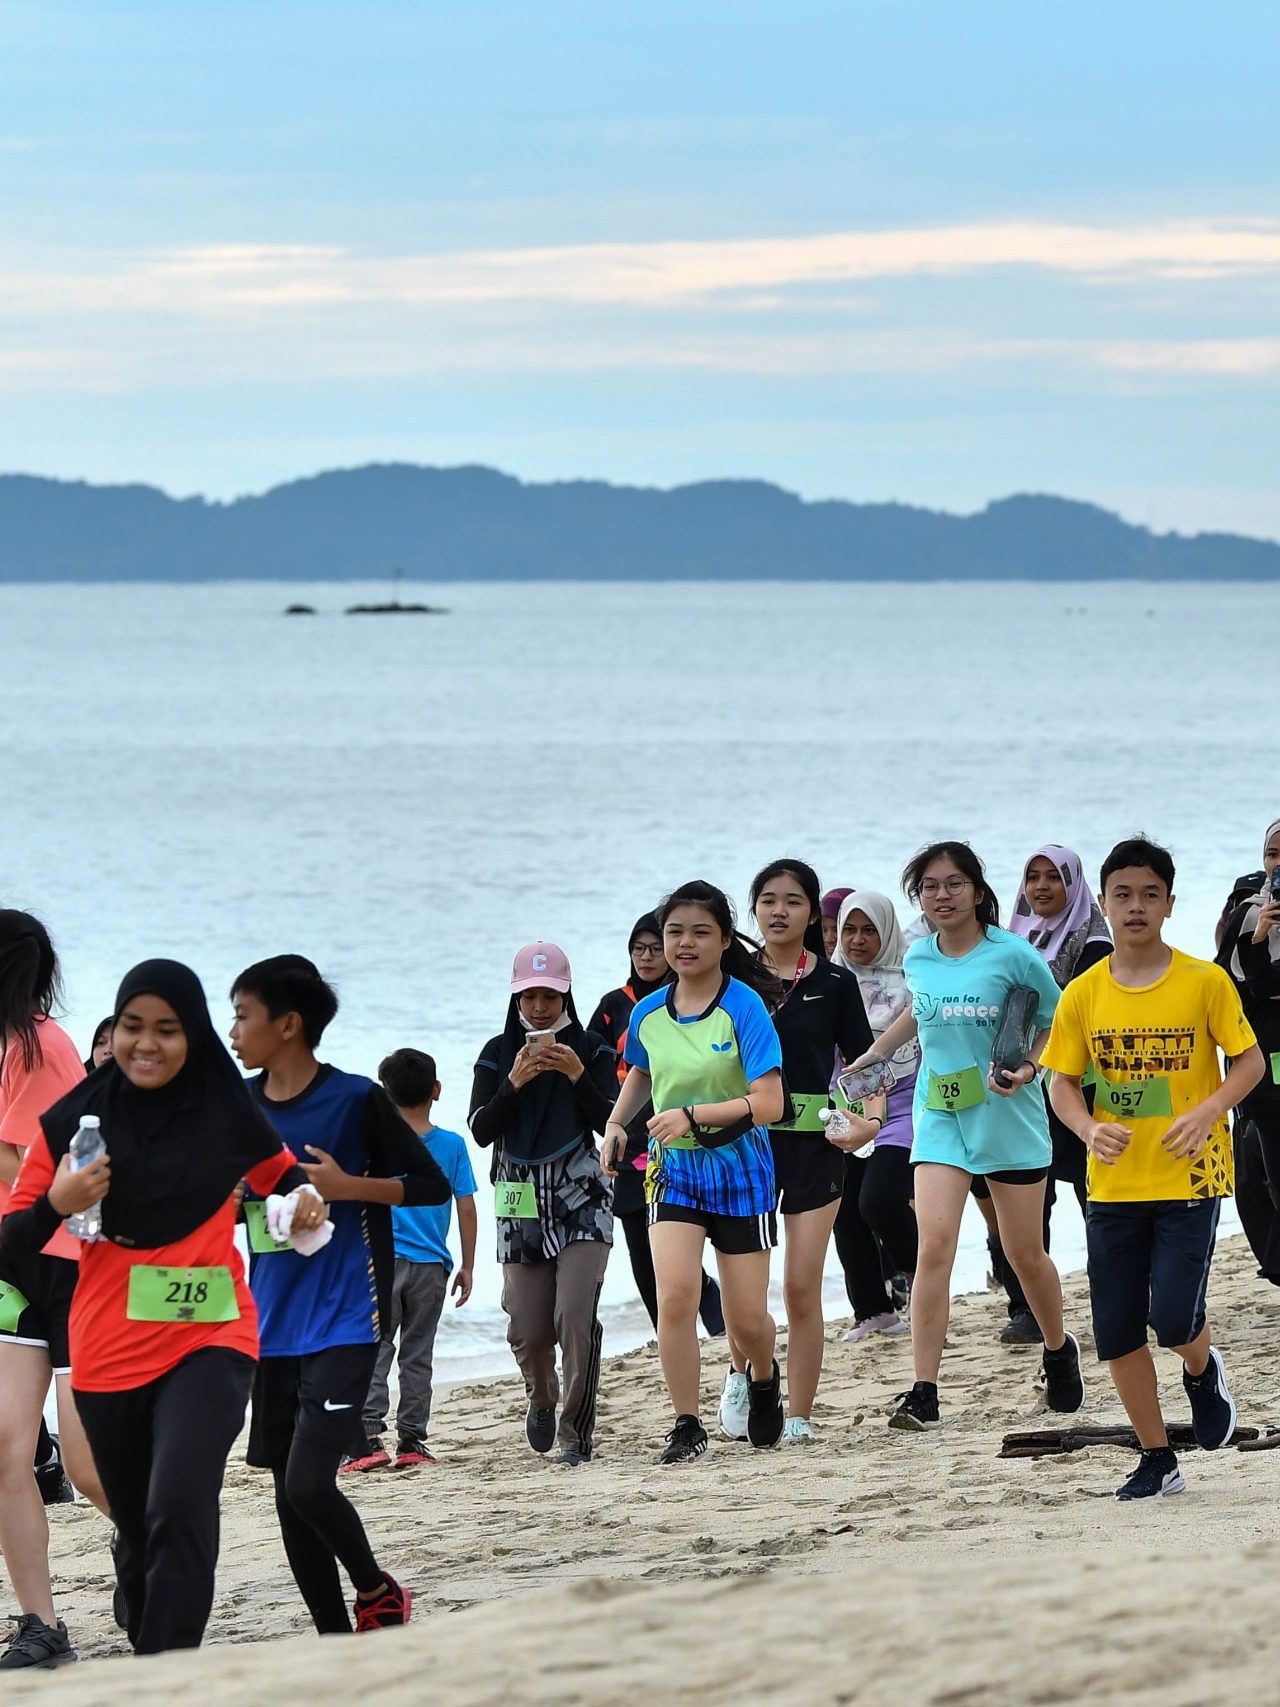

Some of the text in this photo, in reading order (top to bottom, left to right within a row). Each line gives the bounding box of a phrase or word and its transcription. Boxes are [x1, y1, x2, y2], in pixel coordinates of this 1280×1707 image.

[532, 954, 547, 972] C
[942, 994, 981, 1004] run for
[942, 1005, 1000, 1020] peace
[975, 1019, 997, 1028] 2017
[1110, 1091, 1143, 1107] 057
[503, 1190, 523, 1205] 307
[165, 1281, 208, 1304] 218
